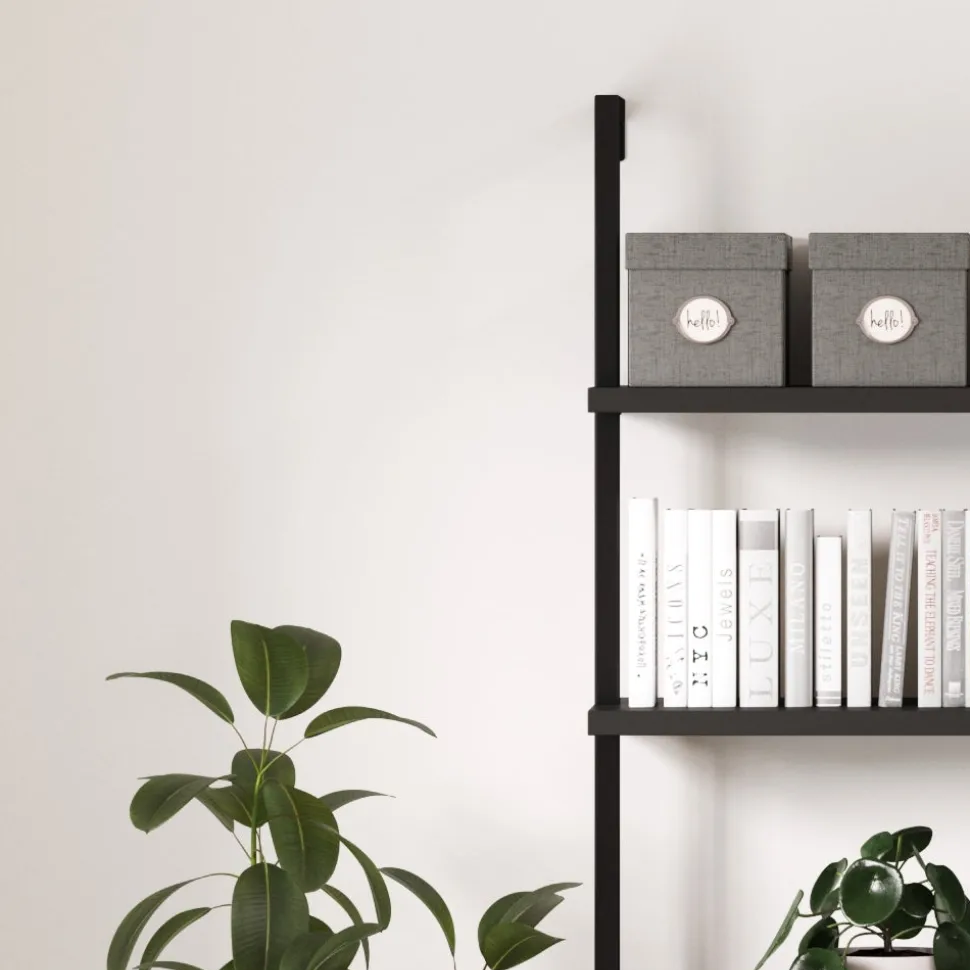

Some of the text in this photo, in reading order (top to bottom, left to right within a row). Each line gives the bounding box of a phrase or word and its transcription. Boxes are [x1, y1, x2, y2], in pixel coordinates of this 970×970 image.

[687, 309, 721, 330] hello!
[870, 309, 904, 330] hello!
[891, 518, 910, 642] TELL IT TO THE KING
[925, 550, 938, 591] TEACHING
[716, 568, 733, 642] Jewels
[788, 561, 805, 655] MILANO
[851, 558, 868, 667] UNSEEN
[924, 592, 937, 608] THE
[749, 563, 773, 699] LUXE
[924, 611, 936, 652] ELEPHANT
[692, 625, 708, 687] NYC
[924, 656, 936, 666] TO
[923, 667, 936, 696] DANCE
